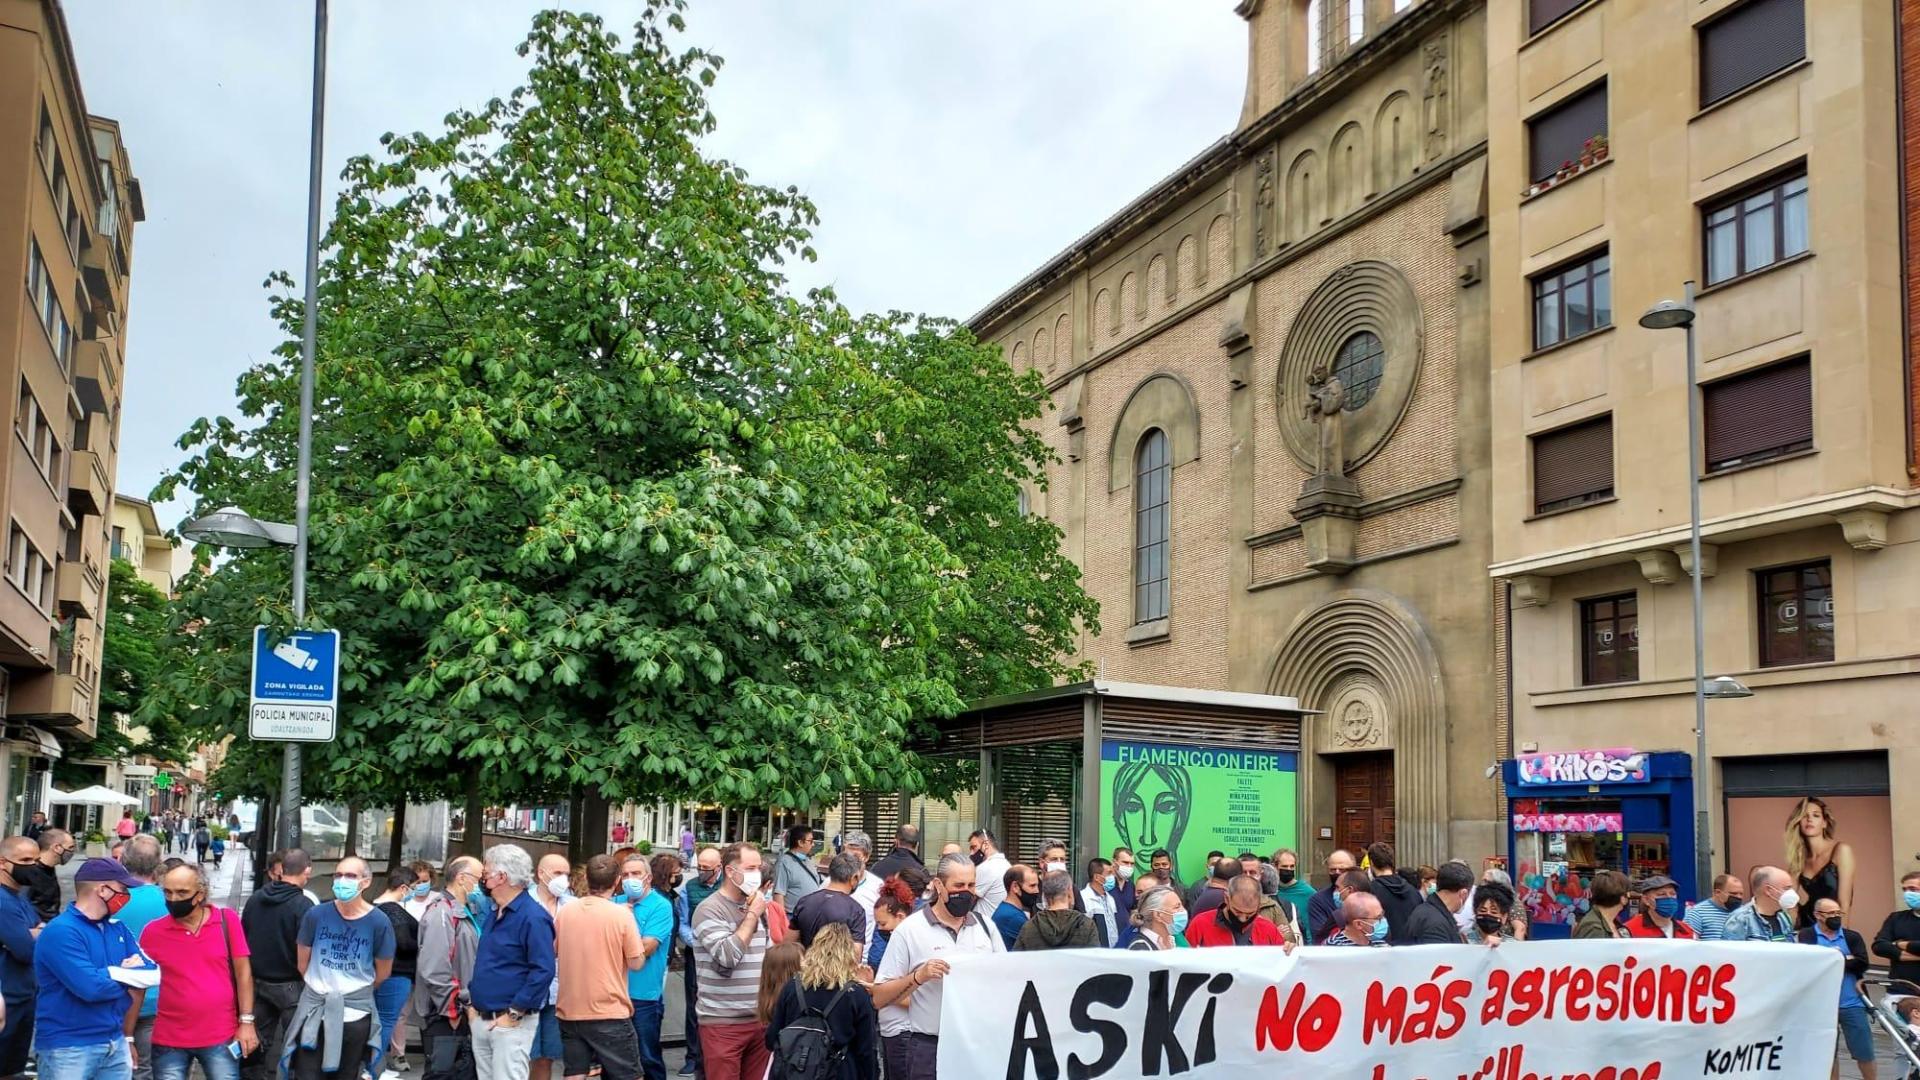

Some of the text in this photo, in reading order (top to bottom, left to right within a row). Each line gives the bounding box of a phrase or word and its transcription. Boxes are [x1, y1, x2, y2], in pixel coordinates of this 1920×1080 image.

[264, 682, 325, 691] ZONA VIGILADA
[255, 709, 331, 722] POLICIA MUNICIPAL
[1119, 746, 1279, 772] FLAMENCO ON FIRE
[319, 926, 370, 952] Brooklyn
[331, 943, 350, 952] NEW
[1480, 956, 1736, 1026] agresiones
